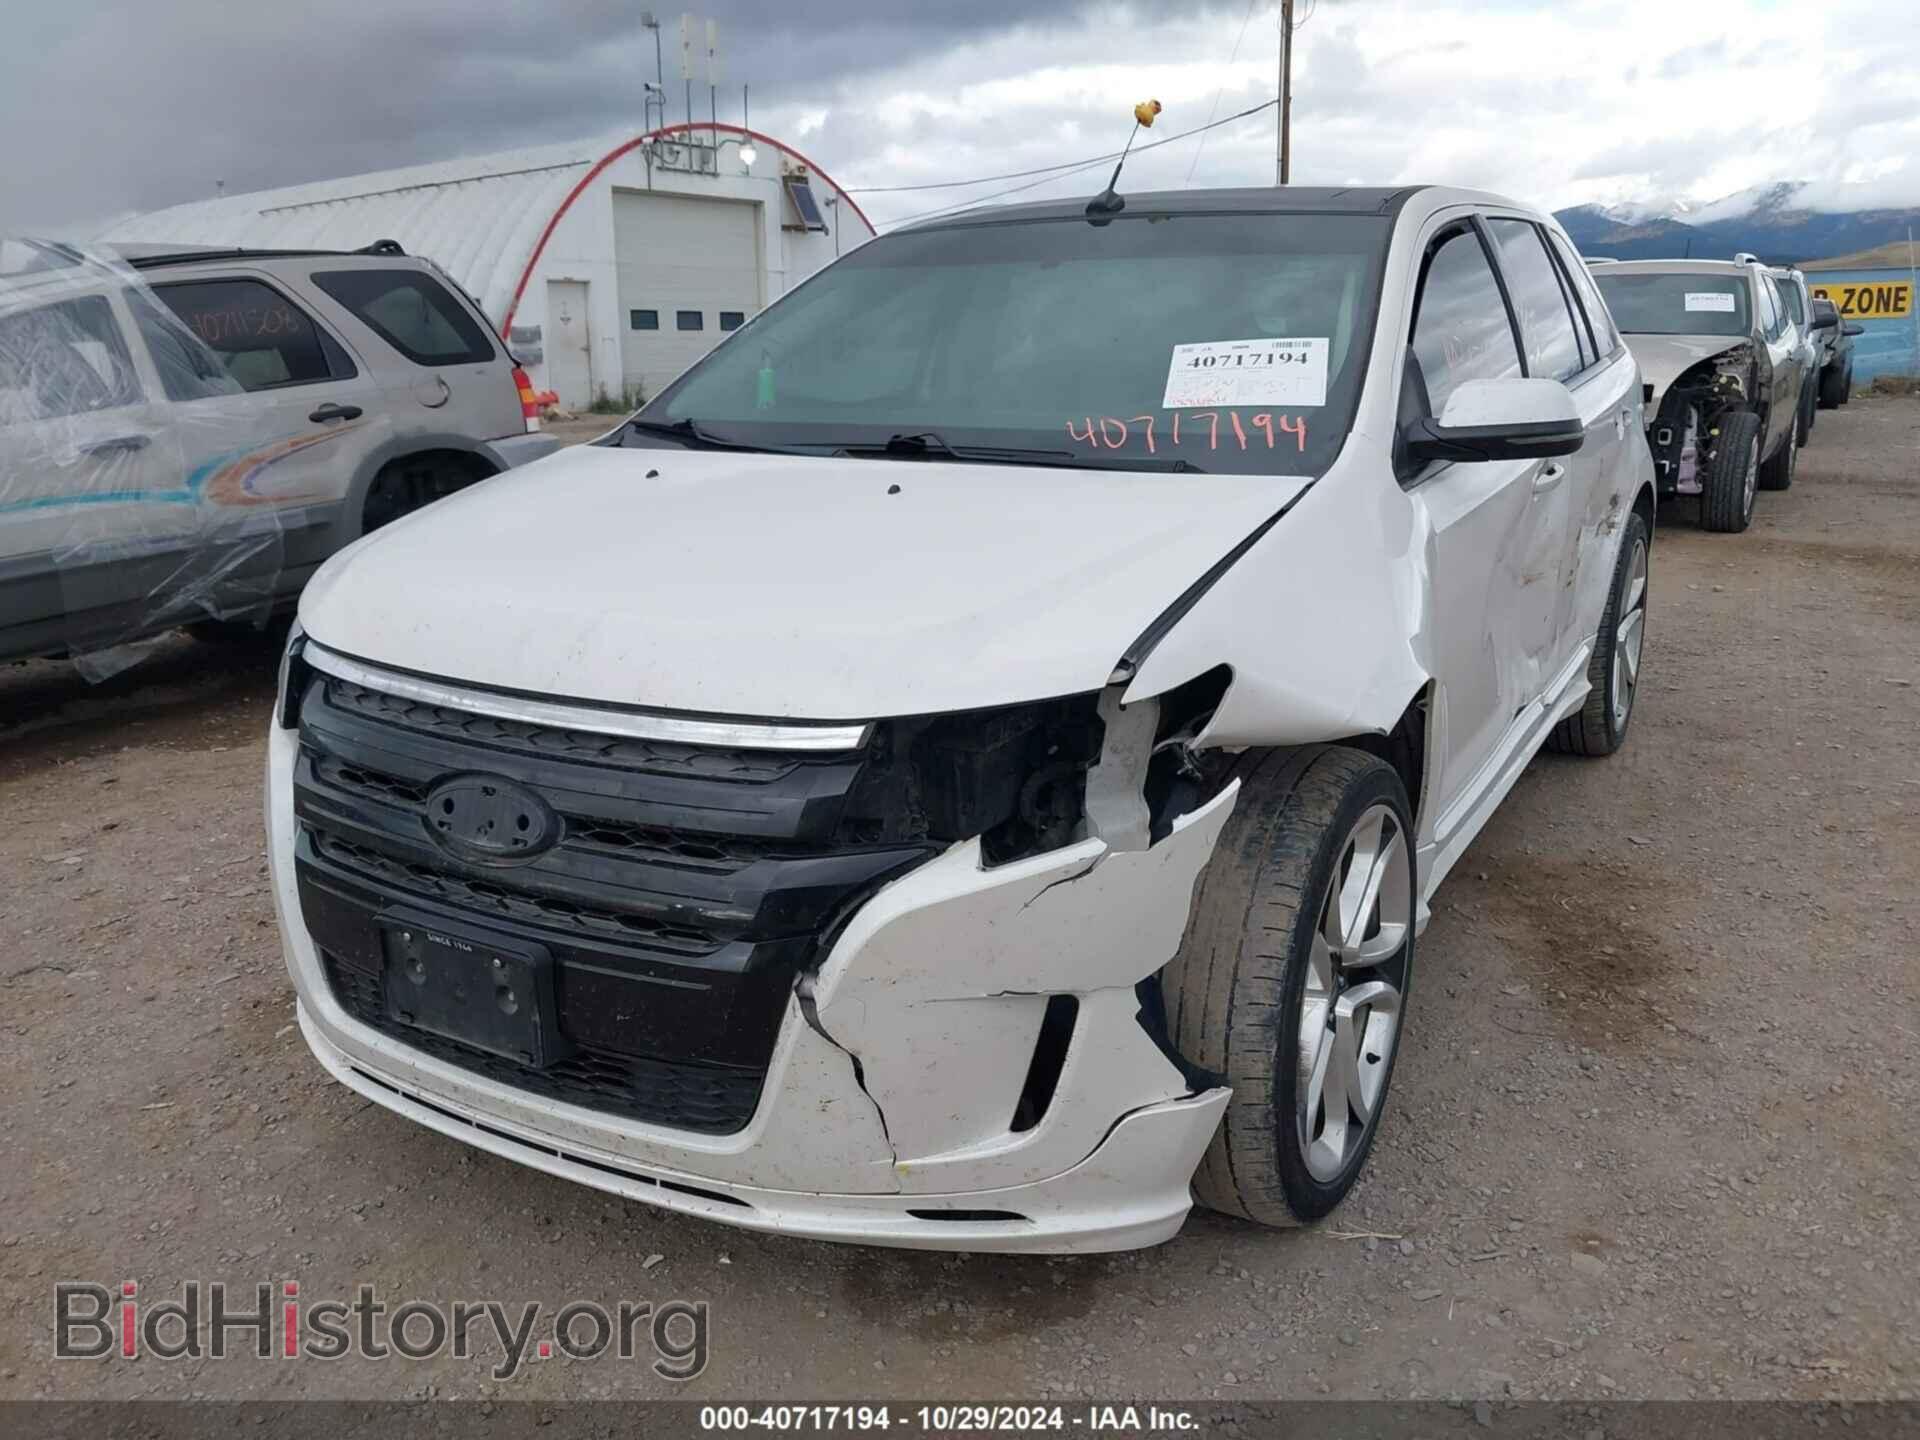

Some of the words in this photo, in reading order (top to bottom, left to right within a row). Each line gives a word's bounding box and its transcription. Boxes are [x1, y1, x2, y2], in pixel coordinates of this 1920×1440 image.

[1841, 286, 1908, 314] ZONE
[1187, 352, 1308, 368] 40717194
[1066, 411, 1306, 454] 40717194
